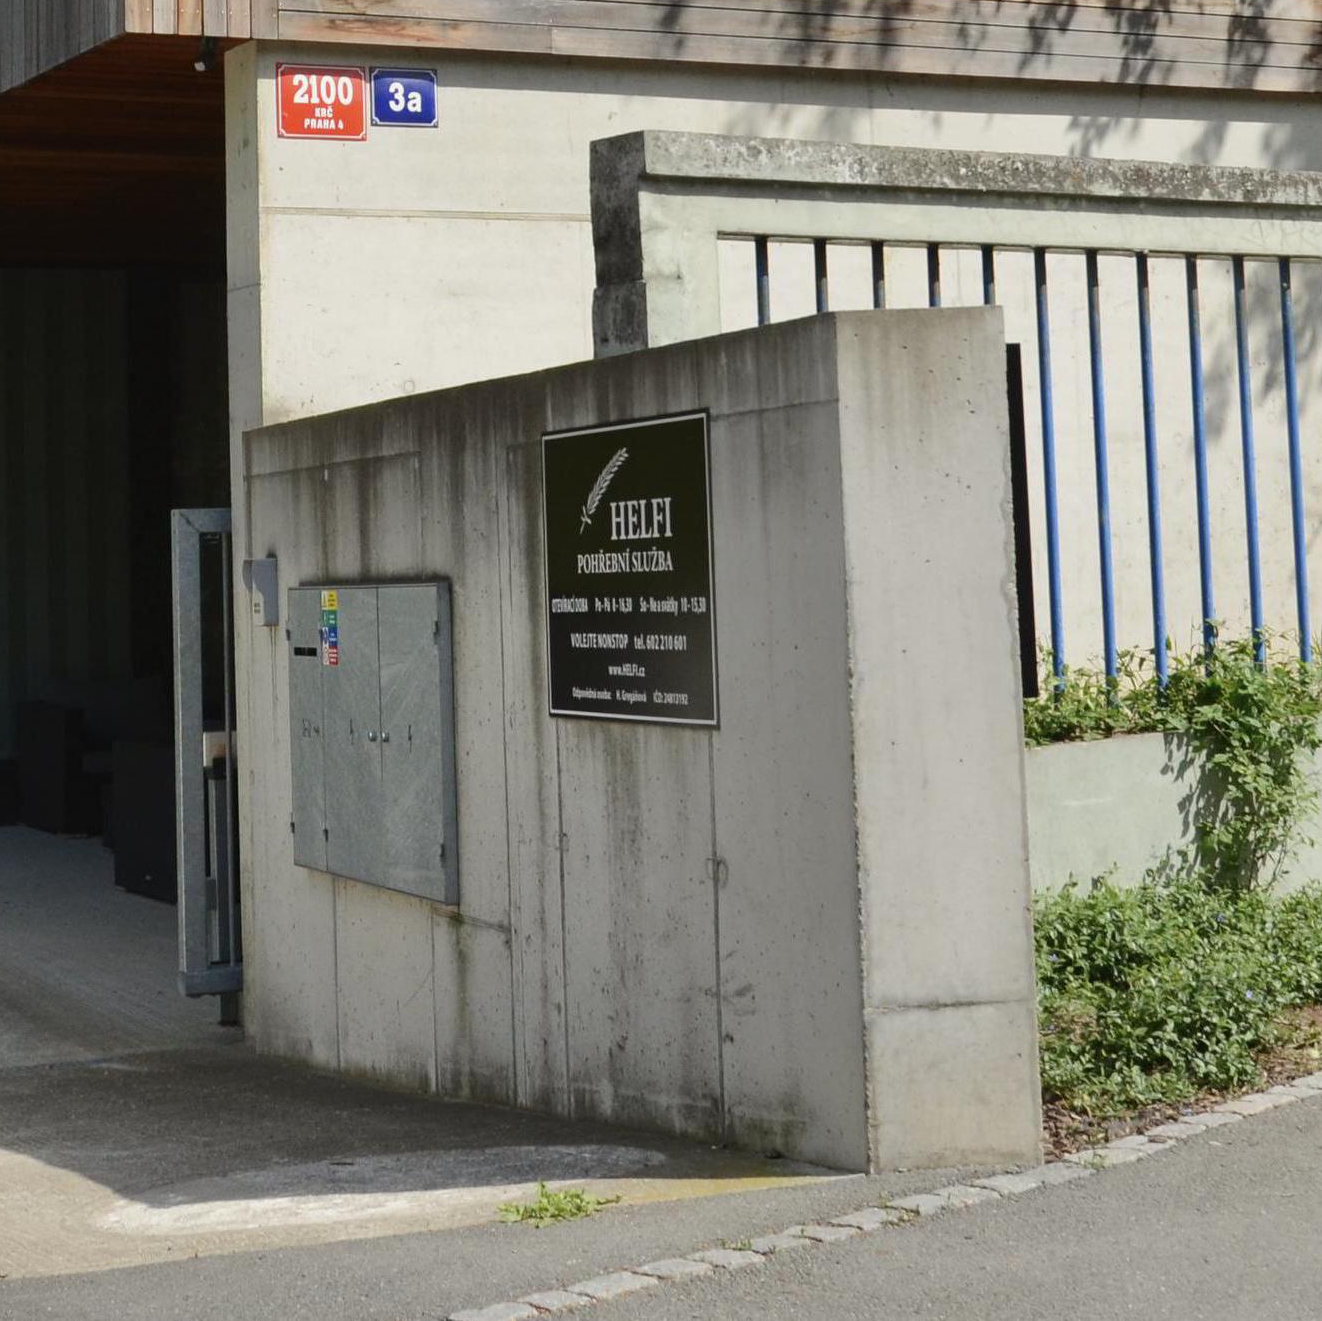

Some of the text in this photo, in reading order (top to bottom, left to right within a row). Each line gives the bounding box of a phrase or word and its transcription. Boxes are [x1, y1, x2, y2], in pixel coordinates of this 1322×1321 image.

[292, 73, 354, 106] 2100
[388, 81, 422, 113] 3a
[304, 118, 344, 130] PRAHA 4
[314, 105, 334, 118] KRČ
[610, 497, 673, 540] HELFI
[577, 546, 673, 575] POHŘEBNÍ SLUŽBA
[571, 632, 687, 651] VOLEJTE NONSTOP tel. 602 210 601
